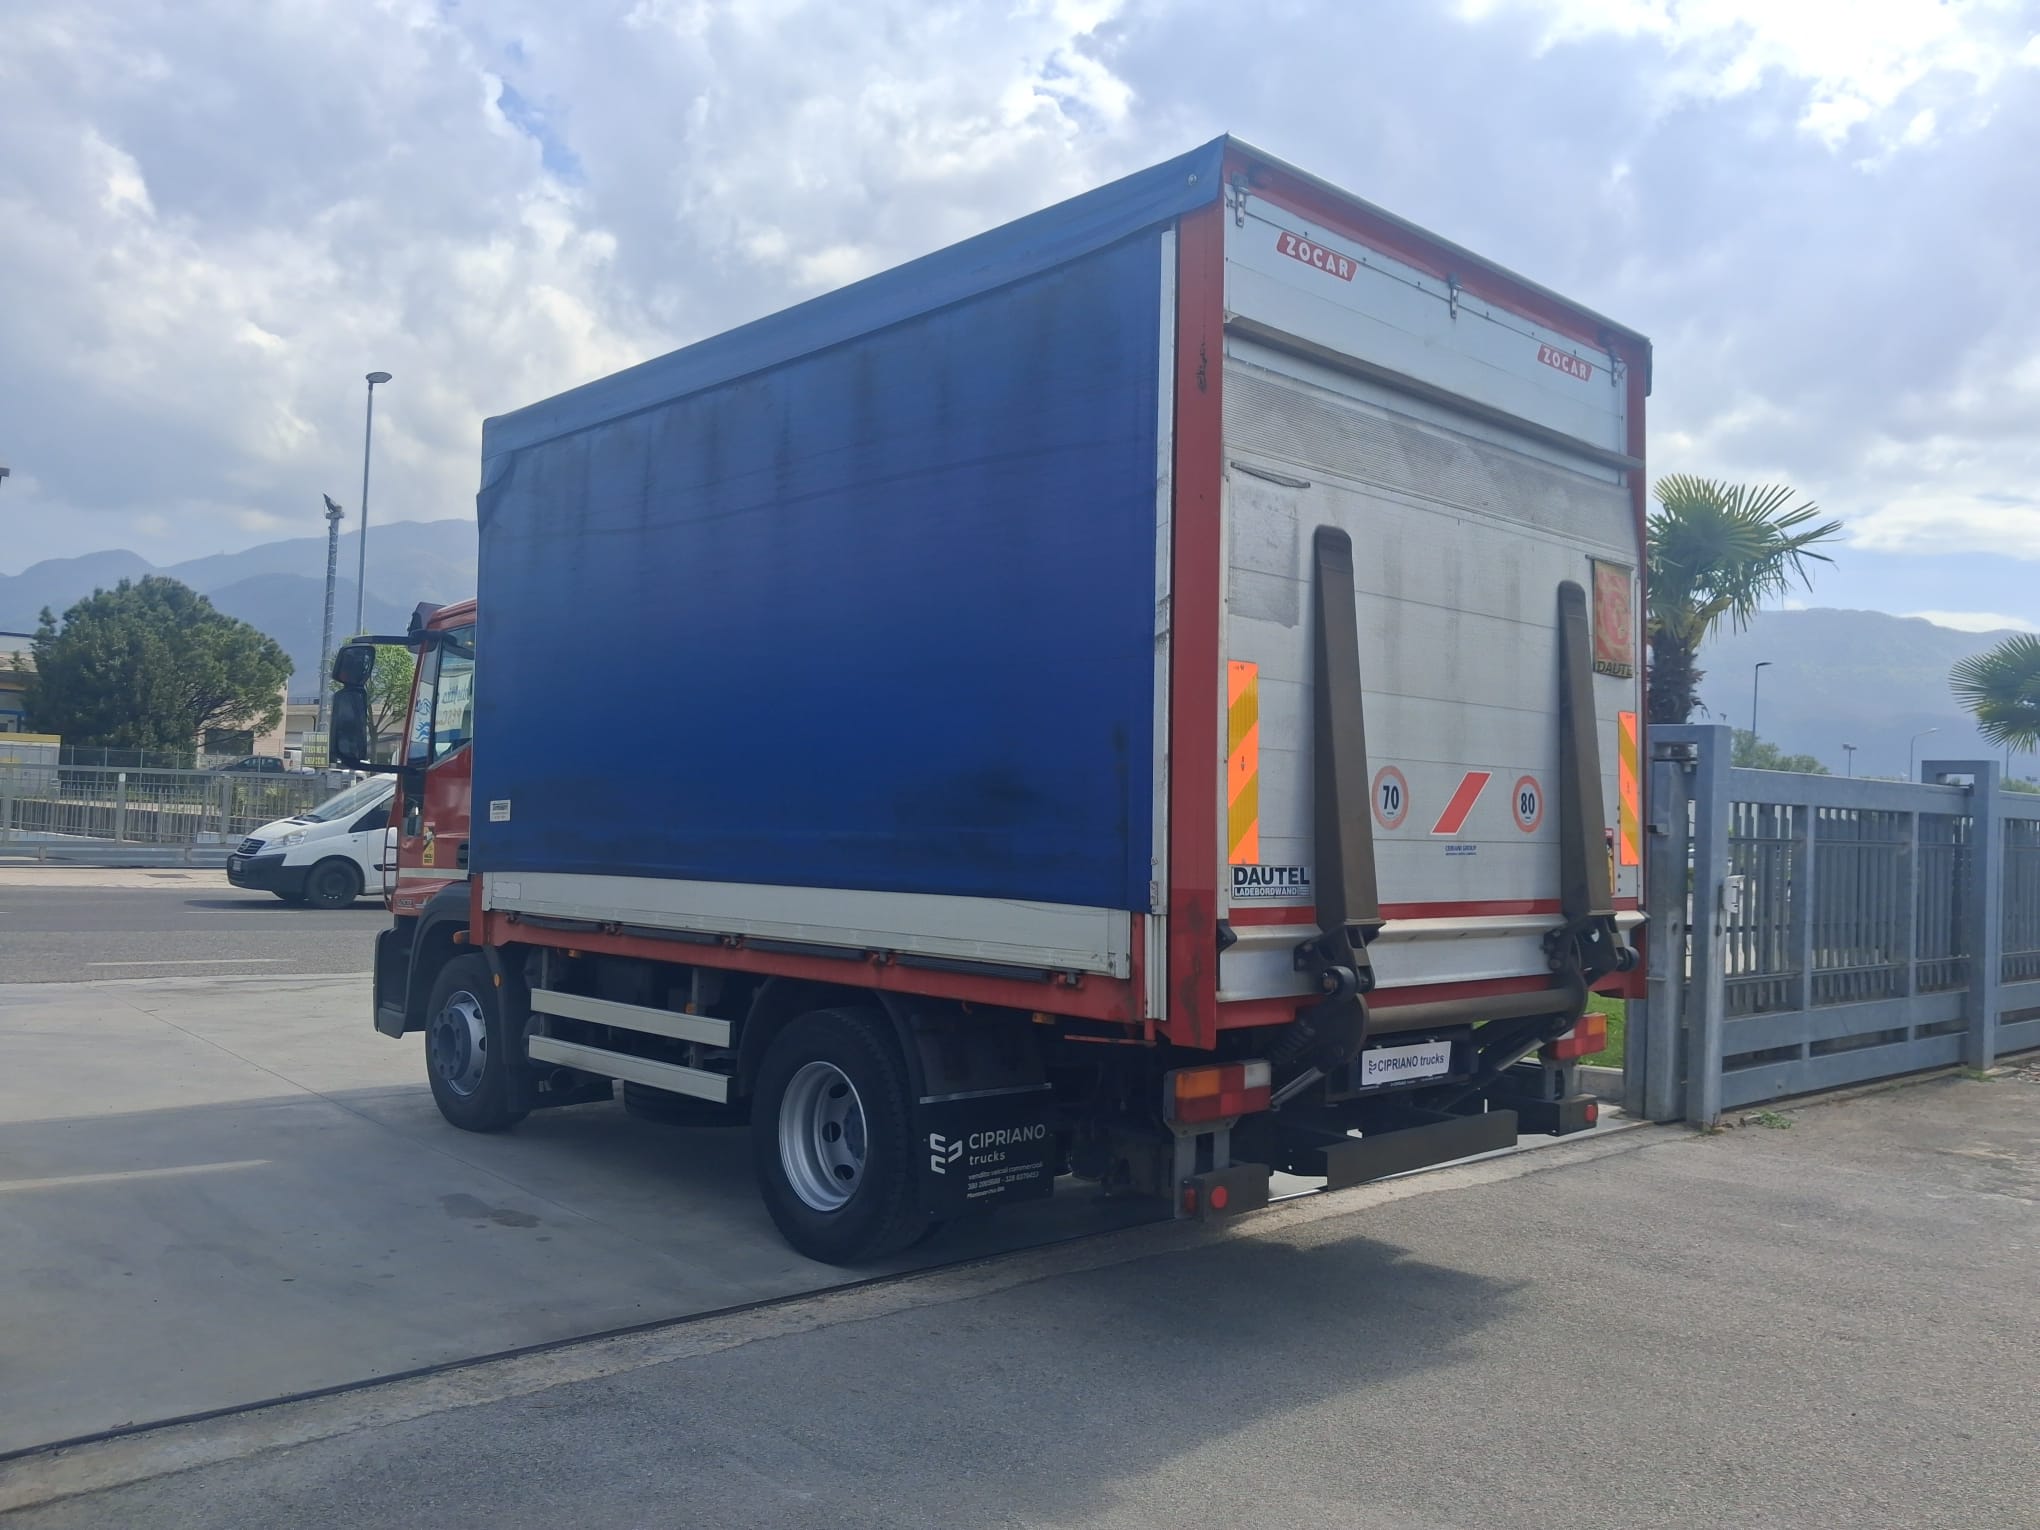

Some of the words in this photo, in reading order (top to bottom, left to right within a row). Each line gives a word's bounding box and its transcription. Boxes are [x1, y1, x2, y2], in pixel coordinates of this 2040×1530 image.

[1286, 235, 1348, 278] ZOCAR
[1543, 347, 1587, 379] ZOCAR
[1597, 660, 1632, 676] DAUTE
[1382, 785, 1400, 810] 70
[1520, 792, 1536, 815] 80
[1233, 866, 1310, 886] DAUTEL
[1234, 887, 1297, 896] LADEBORDWAND
[1377, 1055, 1419, 1073] CIPRIANO
[1420, 1053, 1445, 1067] trucks
[969, 1123, 1046, 1149] CIPRIANO
[969, 1150, 1006, 1165] trucks
